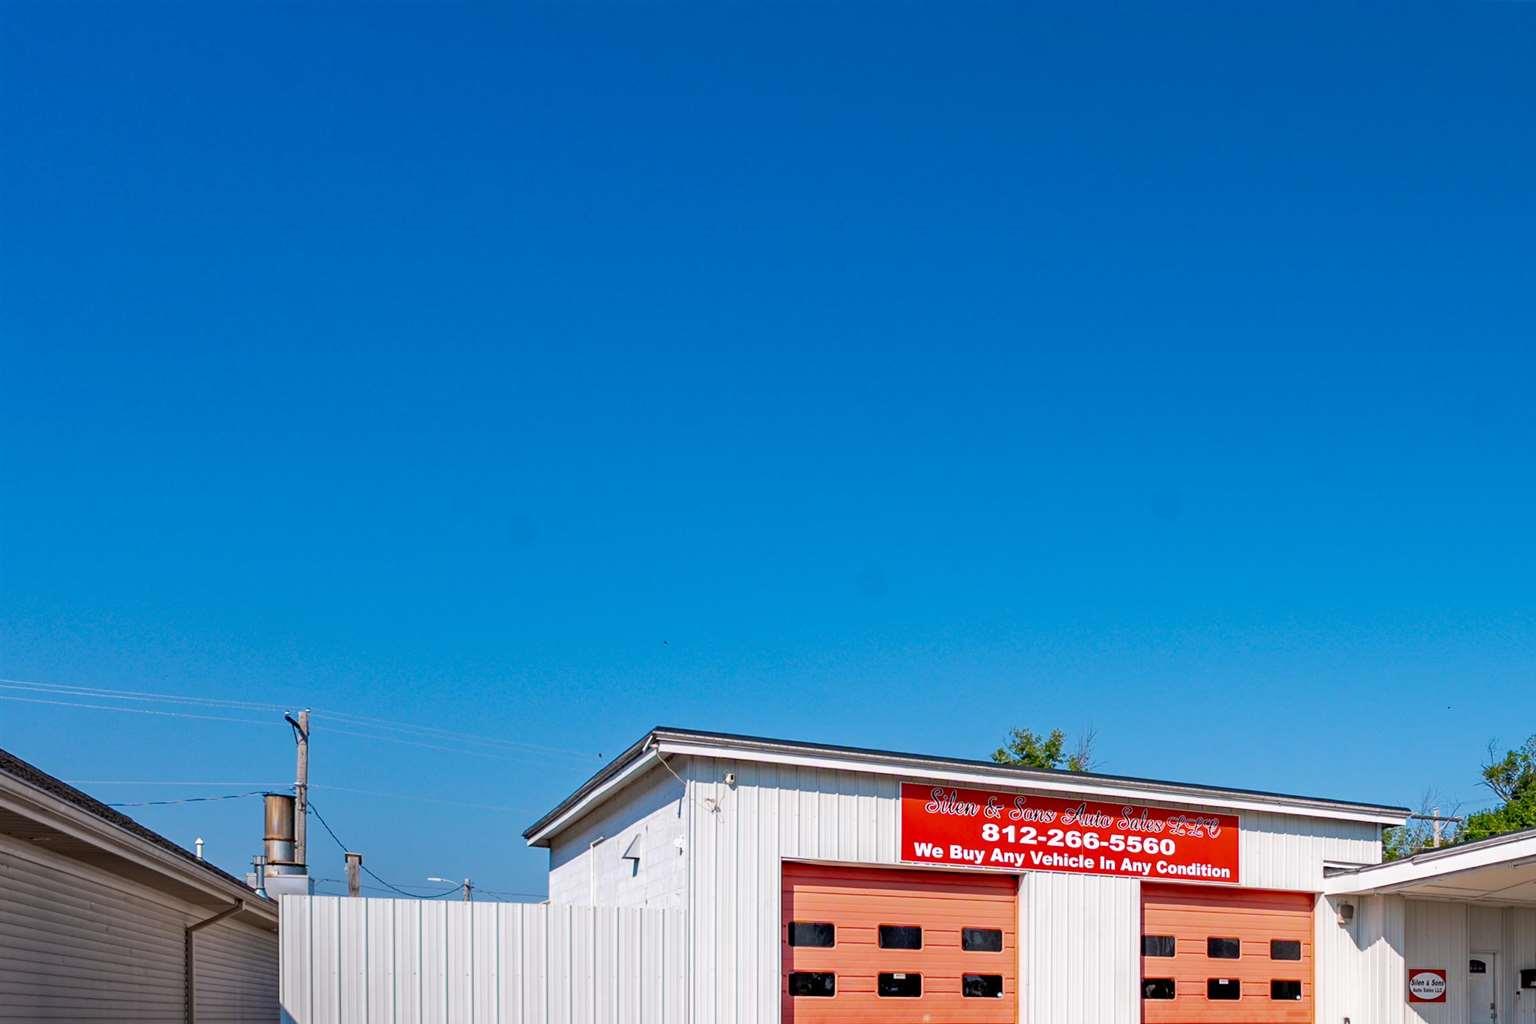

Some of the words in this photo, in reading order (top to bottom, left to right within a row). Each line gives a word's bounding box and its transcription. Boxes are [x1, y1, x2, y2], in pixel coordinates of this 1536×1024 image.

[925, 787, 981, 817] Silen
[983, 795, 1004, 819] &
[1009, 796, 1057, 823] Sons
[1061, 802, 1114, 829] Auto
[1117, 806, 1166, 834] Sales
[1167, 815, 1222, 839] LLC
[981, 823, 1176, 856] 812-266-5560
[914, 842, 944, 858] We
[950, 845, 985, 864] Buy
[990, 848, 1025, 867] Any
[1030, 851, 1095, 870] Vehicle
[1100, 856, 1116, 870] In
[1120, 857, 1151, 876] Any
[1156, 860, 1231, 879] Condition
